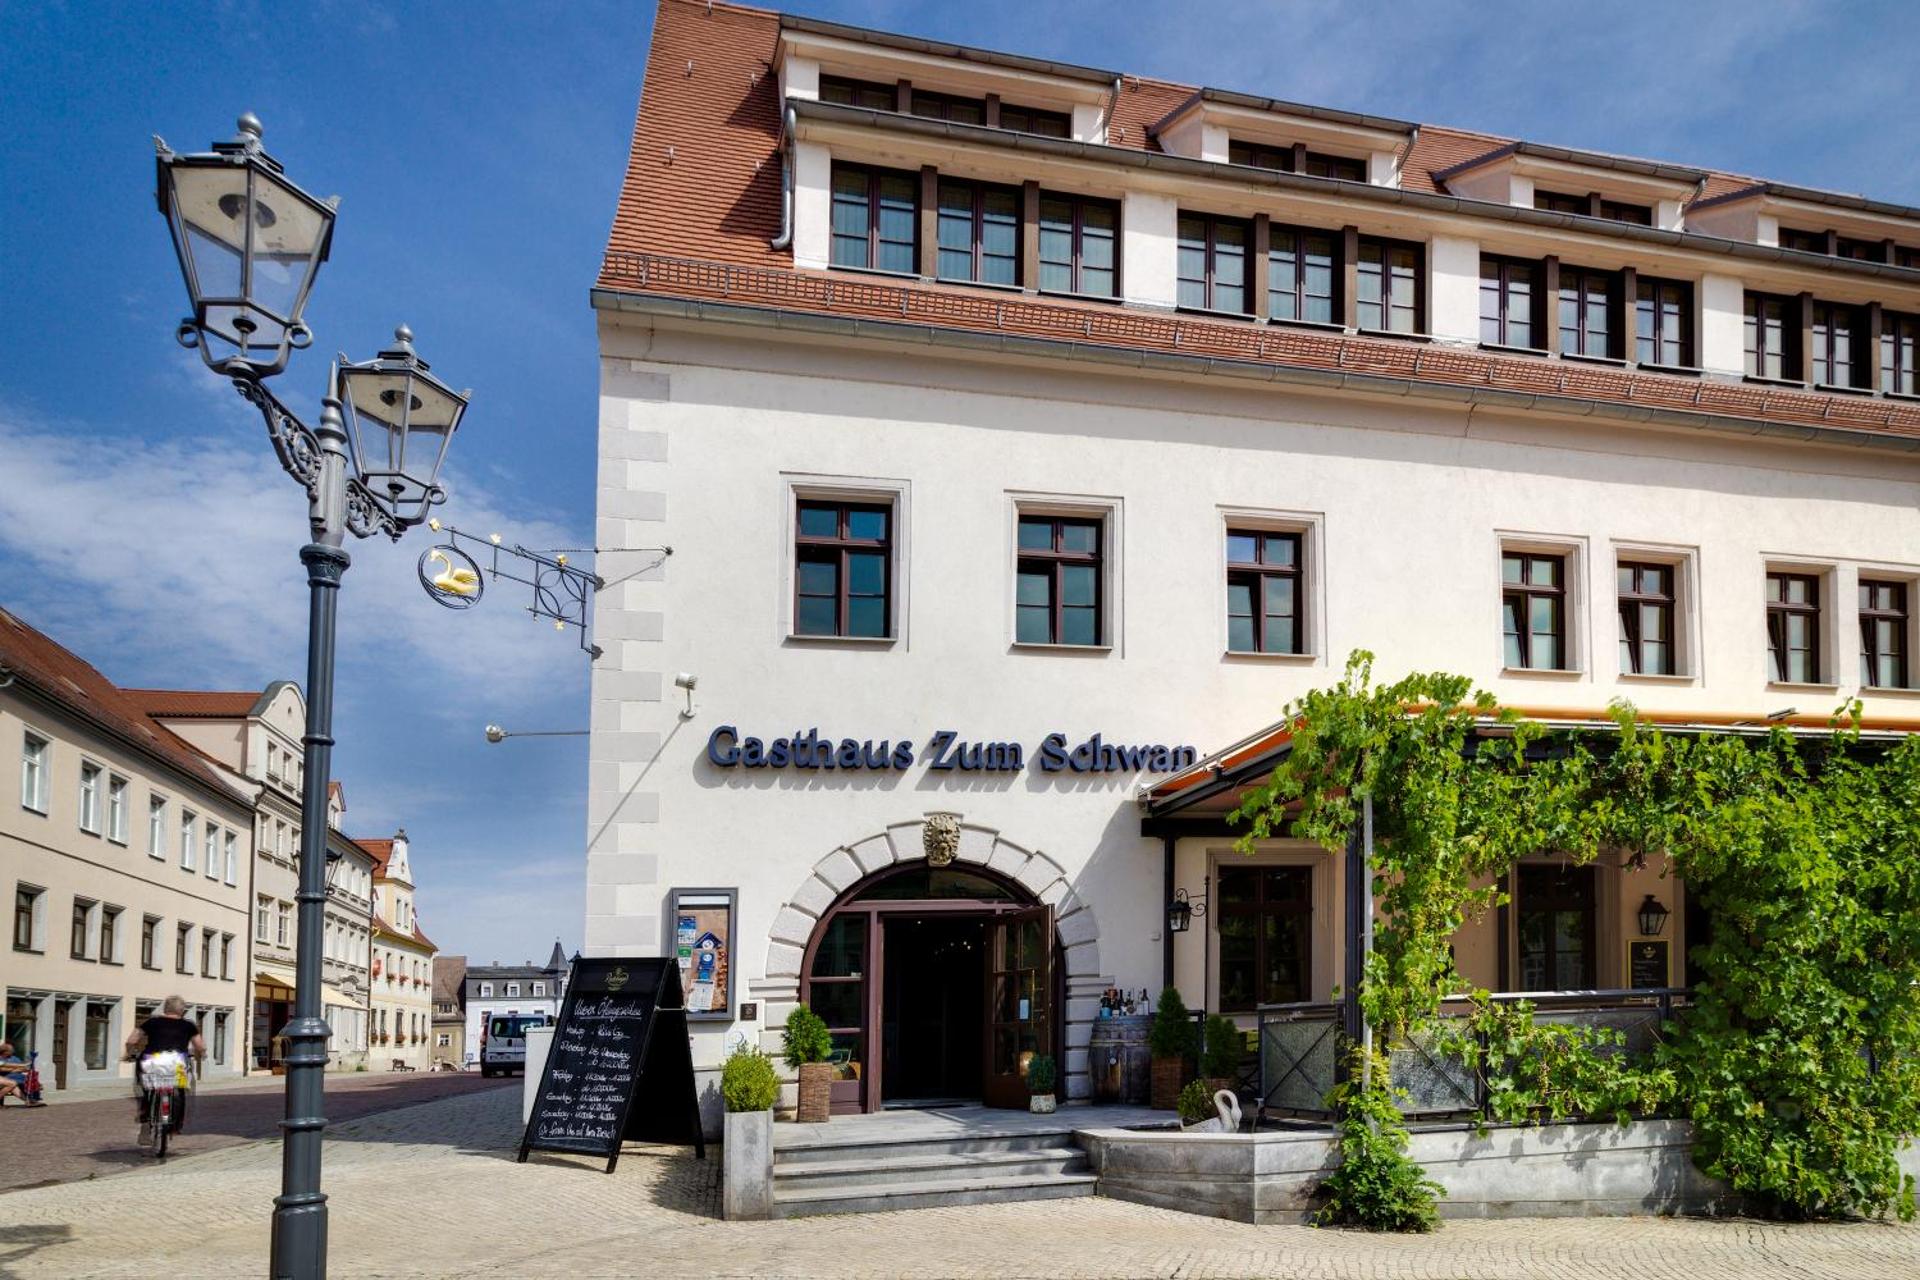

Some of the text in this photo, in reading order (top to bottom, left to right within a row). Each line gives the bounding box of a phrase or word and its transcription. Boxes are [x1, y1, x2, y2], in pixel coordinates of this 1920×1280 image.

[707, 725, 1197, 773] Gasthaus Zum Schwan
